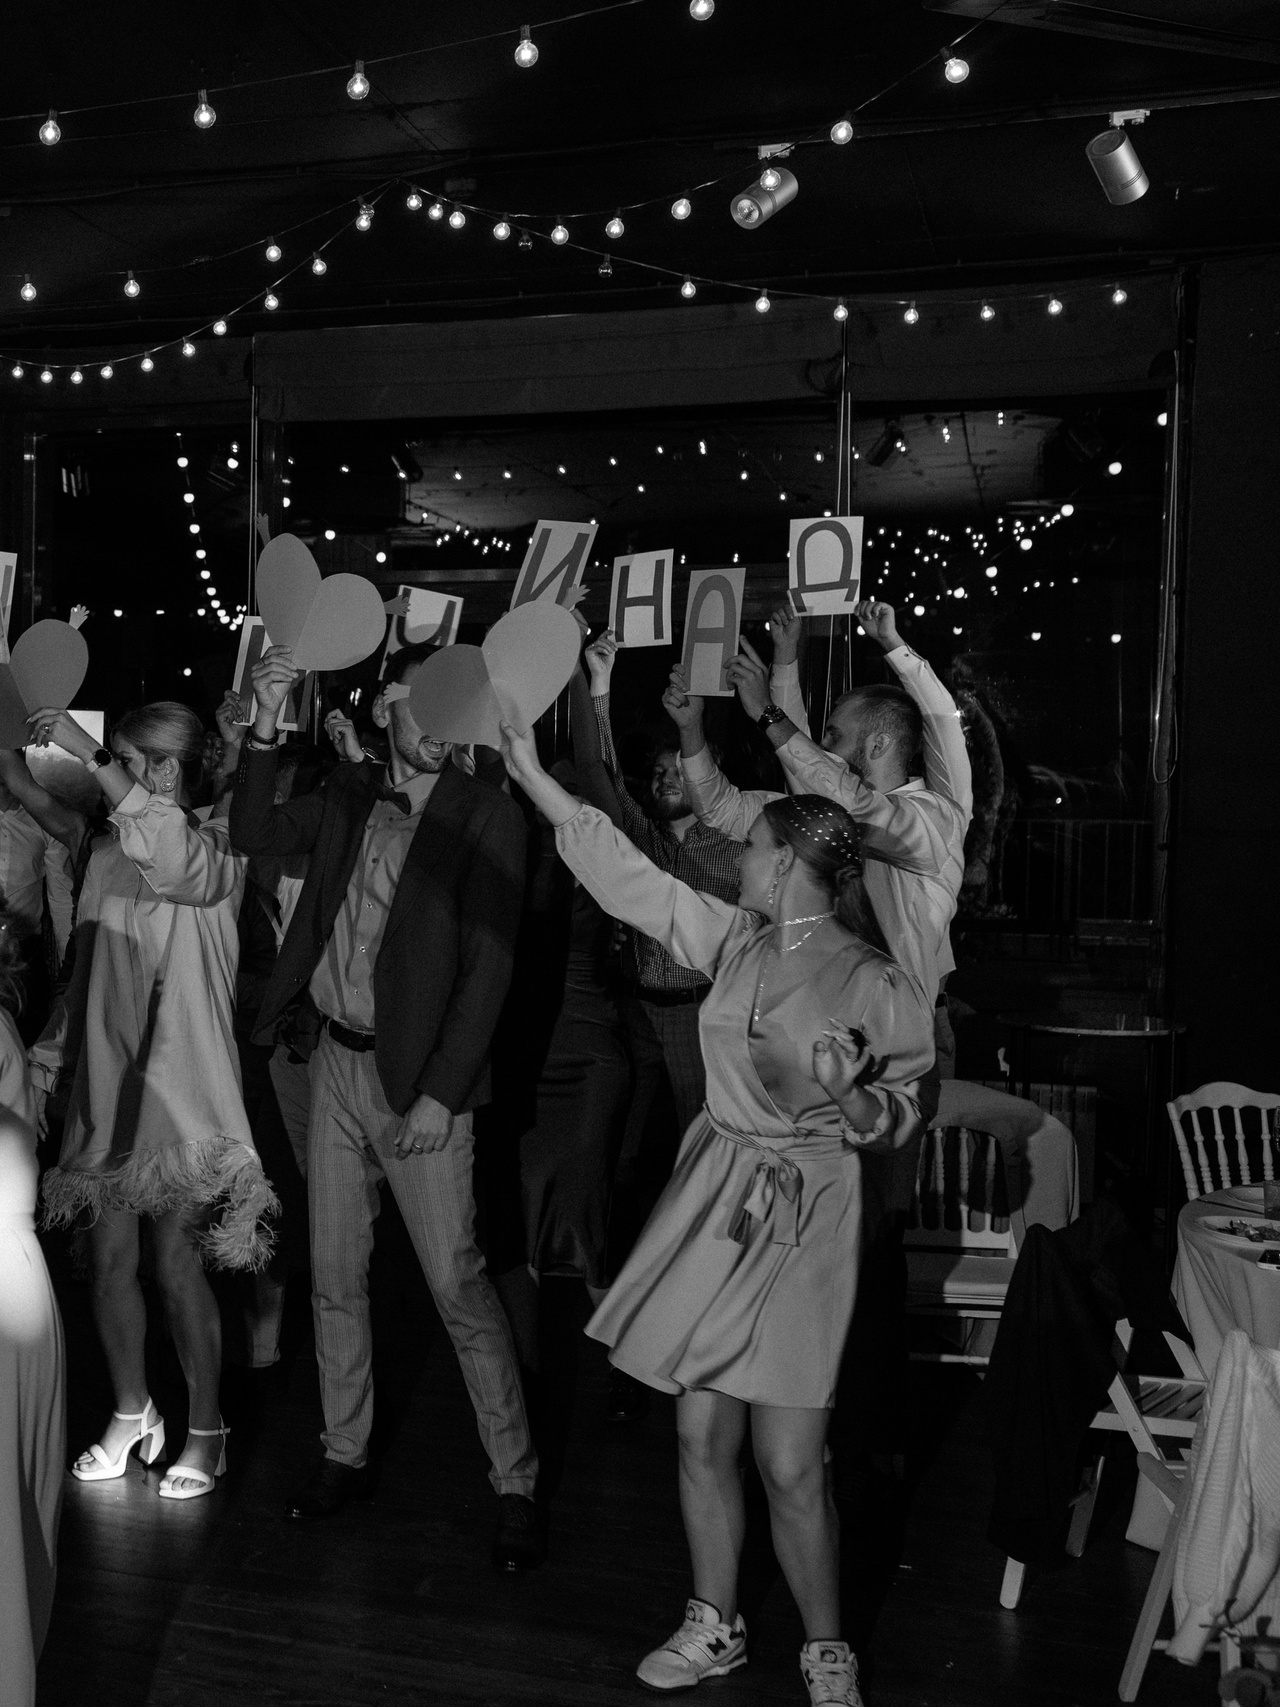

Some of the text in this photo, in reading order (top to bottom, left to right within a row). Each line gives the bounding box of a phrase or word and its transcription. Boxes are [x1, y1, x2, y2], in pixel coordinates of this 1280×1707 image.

[513, 528, 590, 609] И
[615, 559, 666, 642] Н
[789, 520, 859, 613] Д
[682, 574, 737, 691] А
